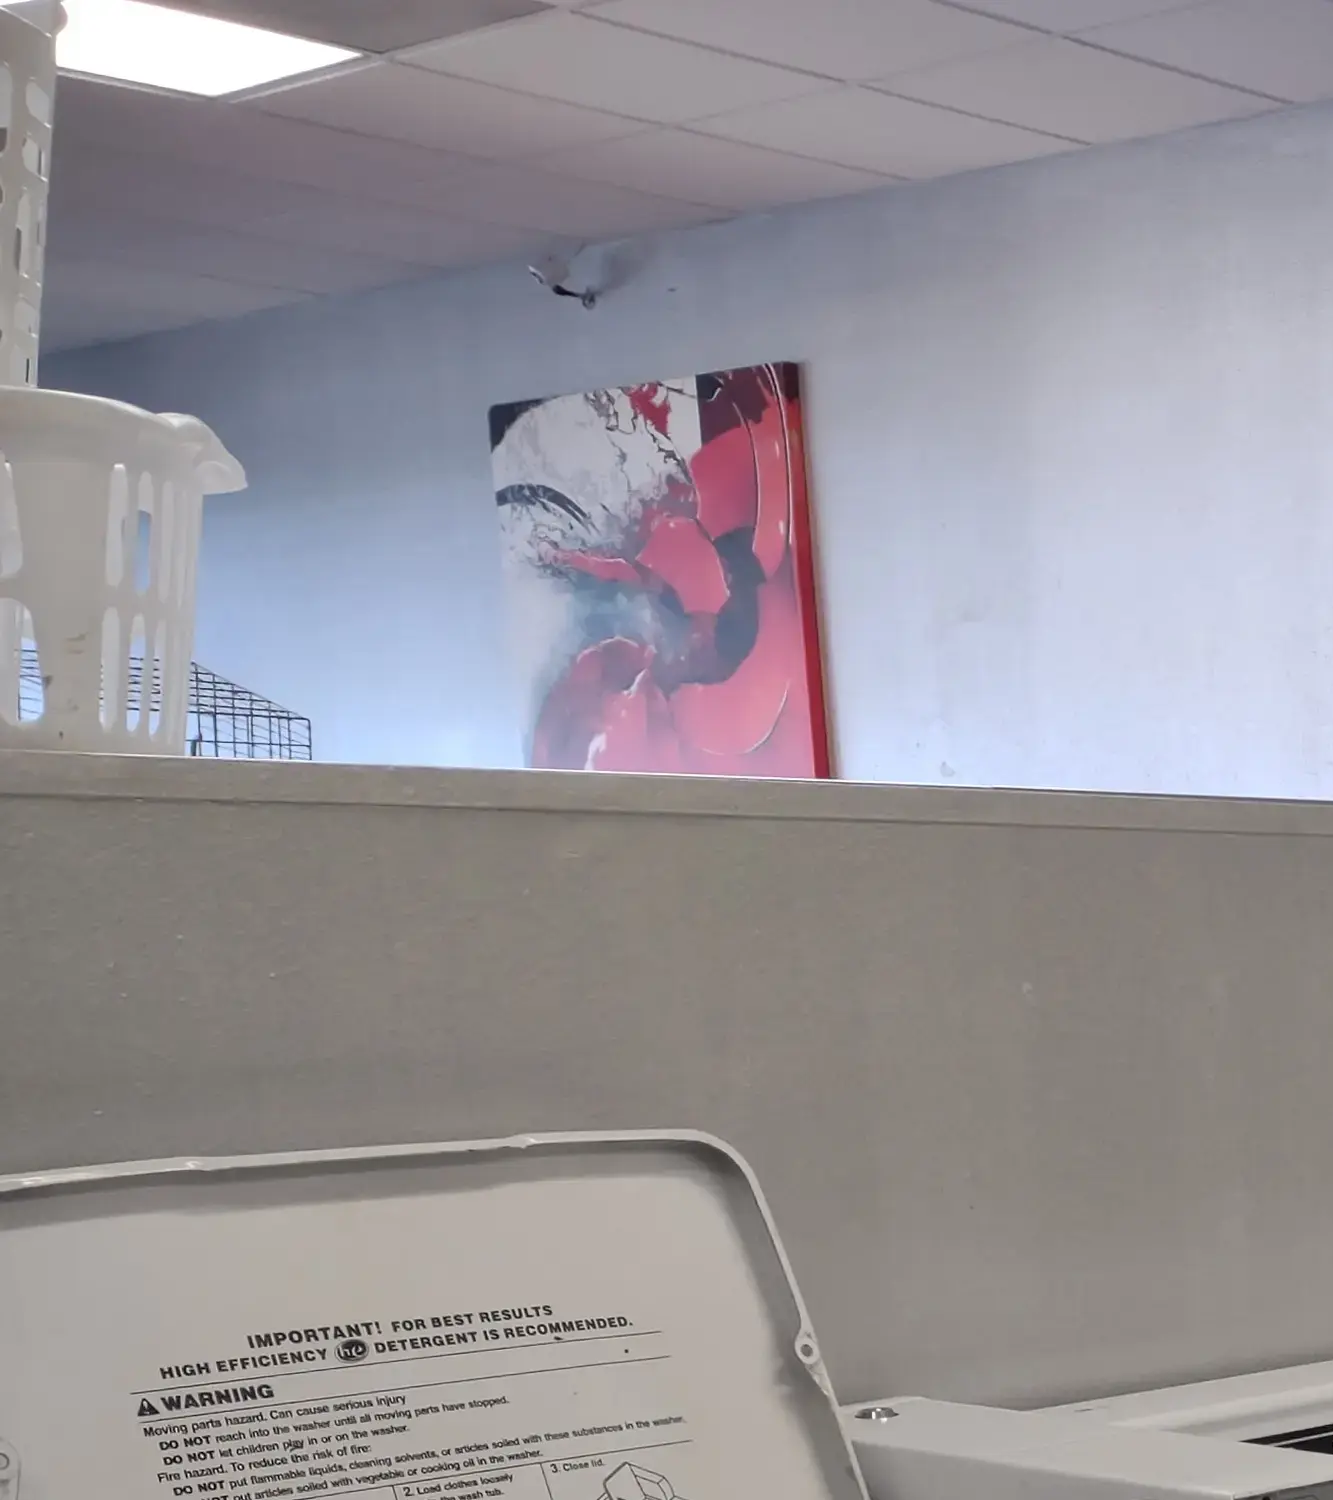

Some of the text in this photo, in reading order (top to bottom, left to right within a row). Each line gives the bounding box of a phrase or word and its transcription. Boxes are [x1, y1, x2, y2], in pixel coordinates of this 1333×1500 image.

[247, 1304, 553, 1348] IMPORTANT! FOR BEST RESULTS
[159, 1316, 633, 1380] HIGH EFFICIENCY DETERGENT IS RECOMMENDED.
[160, 1384, 274, 1411] WARNING
[143, 1424, 189, 1437] Moving
[191, 1418, 222, 1434] parts
[269, 1409, 293, 1420] Can
[296, 1405, 330, 1417] cause
[159, 1439, 179, 1451] DO
[183, 1434, 211, 1448] NOT
[215, 1430, 246, 1443] reach
[248, 1427, 270, 1438] into
[272, 1425, 290, 1435] the
[292, 1420, 331, 1432] washer
[374, 1409, 412, 1421] moving
[414, 1405, 440, 1418] parts
[441, 1402, 465, 1412] have
[157, 1471, 181, 1483] Fire
[229, 1461, 245, 1472] To
[248, 1456, 289, 1470] reduce
[290, 1453, 309, 1463] the
[312, 1448, 334, 1460] risk
[336, 1445, 348, 1457] of
[163, 1454, 183, 1466] DO
[186, 1449, 215, 1463] NOT
[236, 1442, 280, 1456] children
[307, 1436, 318, 1445] in
[321, 1435, 332, 1444] or
[335, 1433, 349, 1442] on
[351, 1430, 368, 1439] the
[172, 1484, 193, 1497] DO
[197, 1479, 225, 1493] NOT
[228, 1477, 248, 1490] put
[250, 1468, 306, 1485] flammable
[349, 1457, 392, 1470] cleaning
[441, 1448, 451, 1456] or
[330, 1476, 353, 1488] with
[407, 1468, 418, 1476] or
[421, 1461, 461, 1474] cooking
[463, 1458, 476, 1468] oil
[562, 1461, 589, 1472] Close
[416, 1483, 442, 1495] Load
